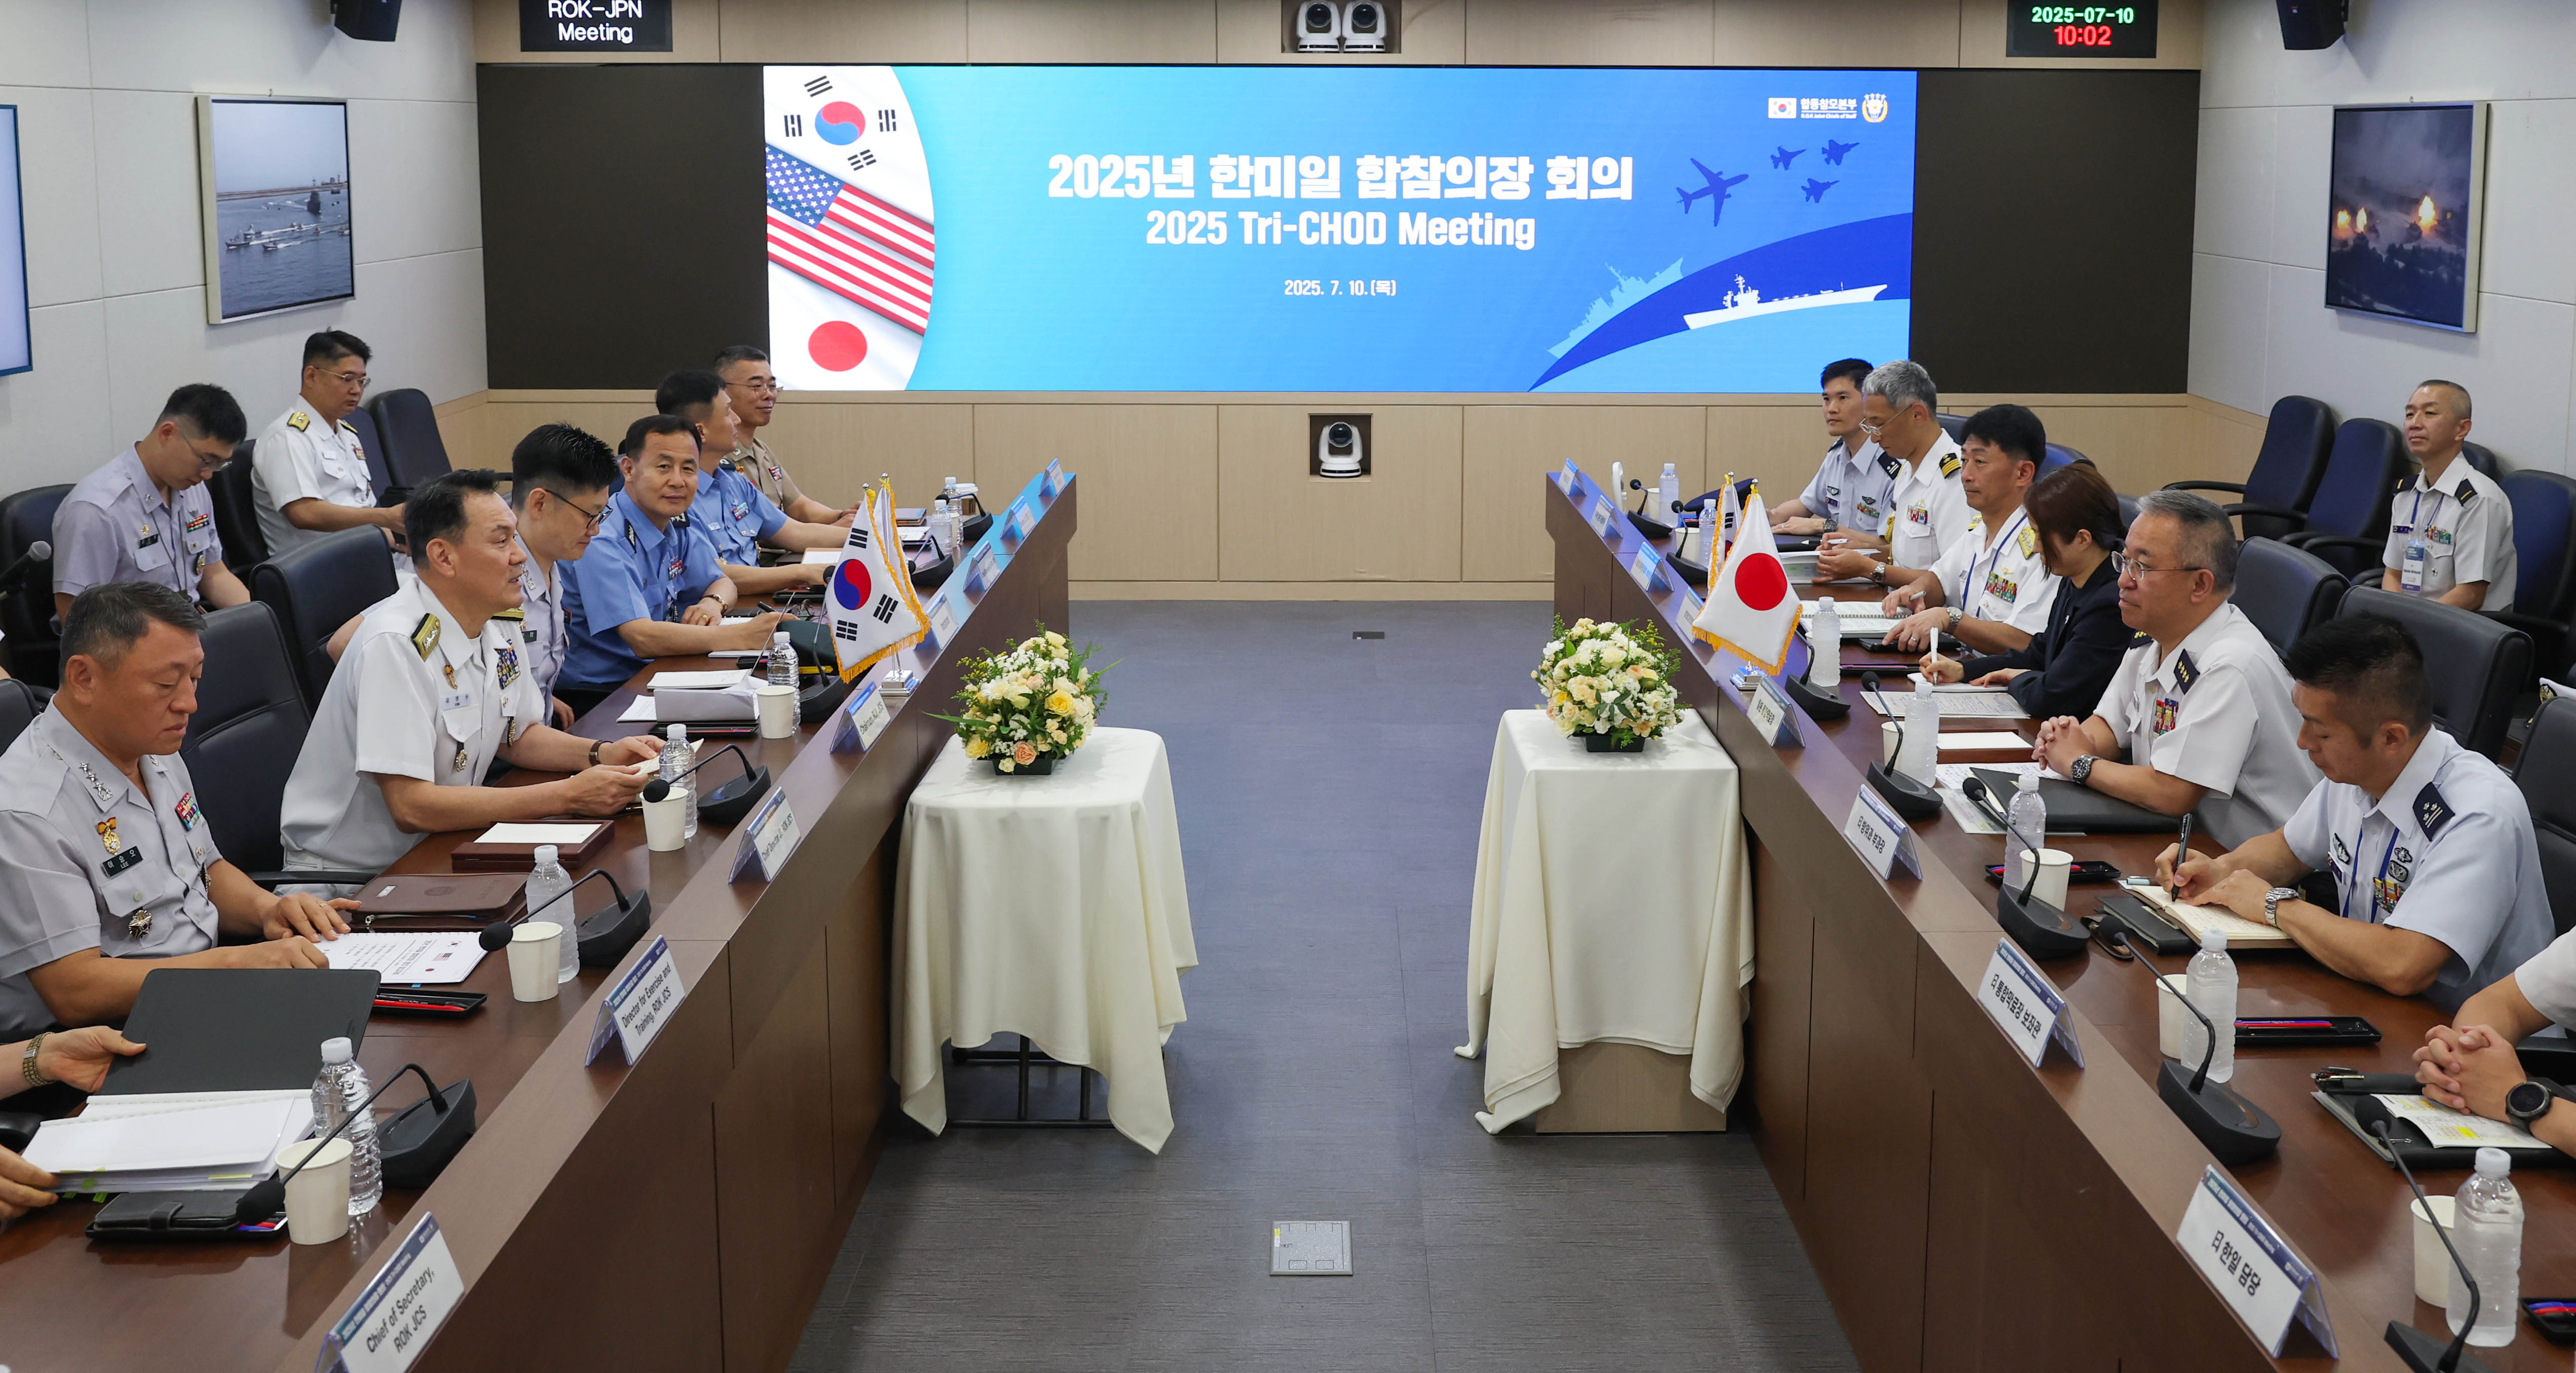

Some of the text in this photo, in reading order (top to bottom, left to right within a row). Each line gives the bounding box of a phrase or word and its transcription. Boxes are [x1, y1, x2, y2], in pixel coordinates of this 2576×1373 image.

[548, 0, 642, 18] ROK-JPN
[2031, 6, 2134, 23] 2025-07-10
[558, 23, 633, 44] Meeting
[2053, 25, 2112, 46] 10:02
[1048, 153, 1633, 200] 2025년 한미일 합참의장 회의
[1146, 210, 1536, 251] 2025 Tri-CHOD Meeting
[1284, 279, 1325, 296] 2025.
[1330, 280, 1343, 296] 7.
[1872, 832, 1887, 854] 부과장
[621, 962, 672, 1029] Director for Exercise and
[634, 986, 672, 1037] Training, ROK JCS
[1995, 980, 2025, 1019] 통합막료장
[2021, 1009, 2042, 1039] 보좌관
[2219, 1241, 2242, 1275] 한일
[2238, 1263, 2262, 1297] 담당
[366, 1317, 388, 1353] Chief
[389, 1306, 399, 1326] of
[395, 1266, 435, 1315] Secretary,
[393, 1305, 427, 1353] ROK JCS
